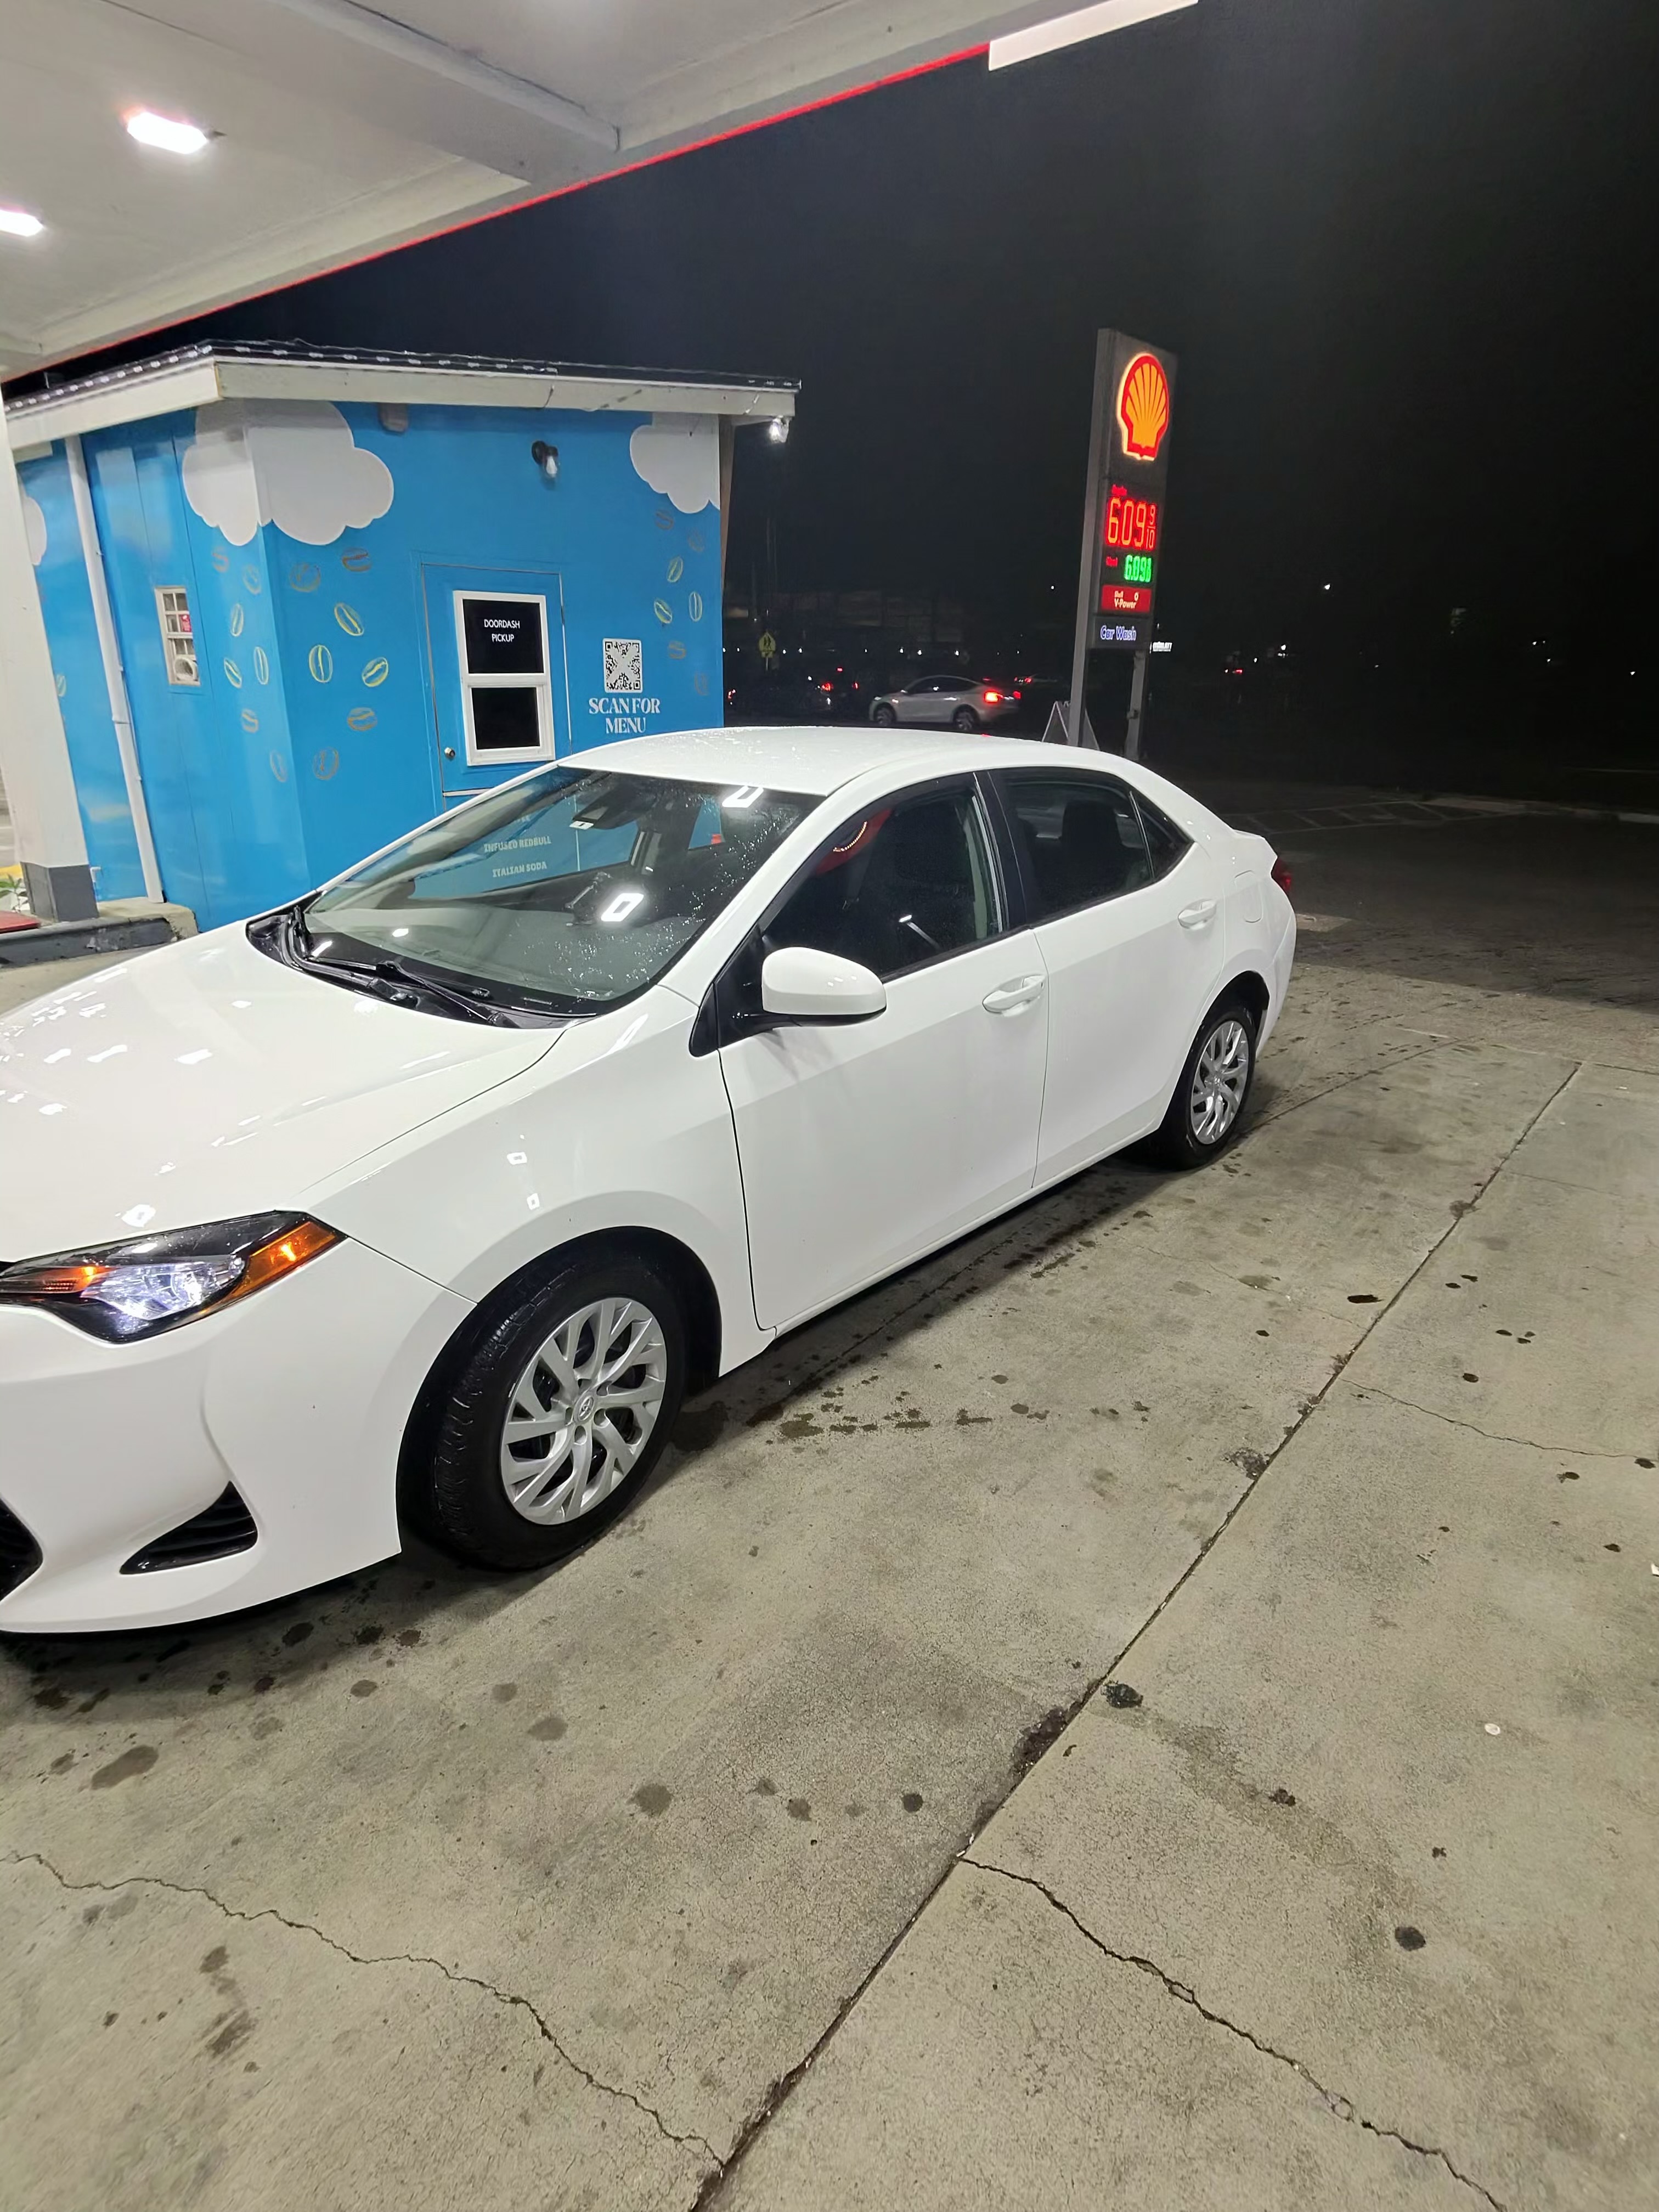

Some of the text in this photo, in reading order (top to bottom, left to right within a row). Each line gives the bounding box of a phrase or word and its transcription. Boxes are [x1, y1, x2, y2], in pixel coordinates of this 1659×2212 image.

[484, 619, 520, 629] DOORDASH
[492, 634, 515, 642] PICKUP
[1101, 625, 1137, 641] Car Wash
[589, 697, 661, 714] SCAN FOR
[606, 717, 646, 734] MENU
[492, 861, 547, 878] ITALIAN SODA
